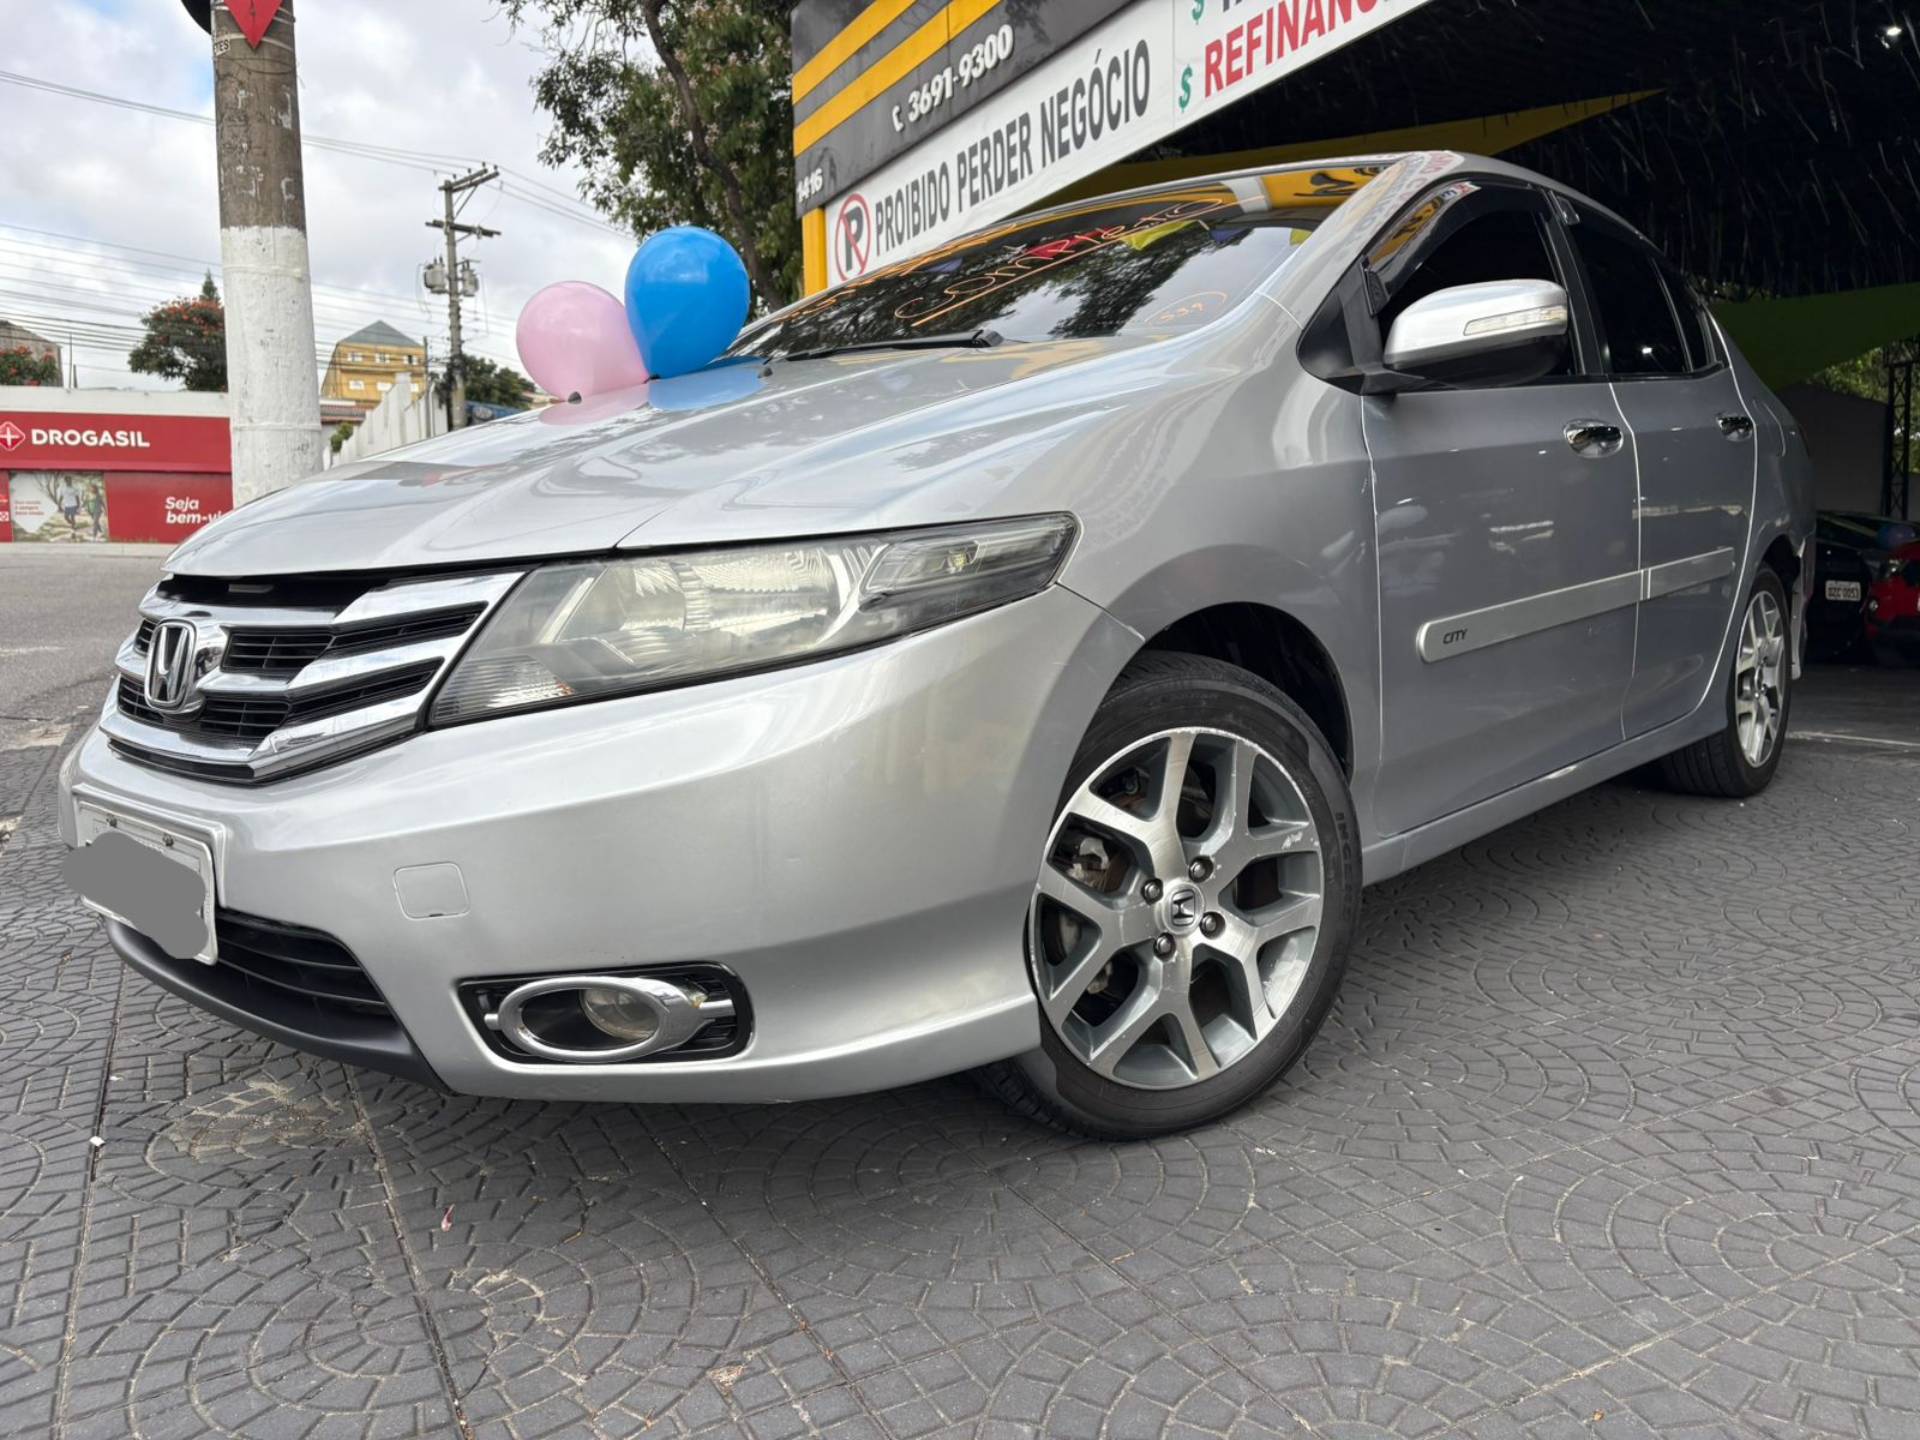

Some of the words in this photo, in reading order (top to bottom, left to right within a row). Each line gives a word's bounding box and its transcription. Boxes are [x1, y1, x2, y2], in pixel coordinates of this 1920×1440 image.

[908, 24, 1014, 123] 3691-9300
[1205, 0, 1377, 98] REFINA
[875, 160, 950, 257] PROIBIDO
[957, 112, 1033, 213] PERDER
[1040, 39, 1150, 168] NEGÓCIO
[31, 428, 150, 447] DROGASIL
[165, 496, 200, 512] Seja
[1442, 628, 1468, 644] CITY
